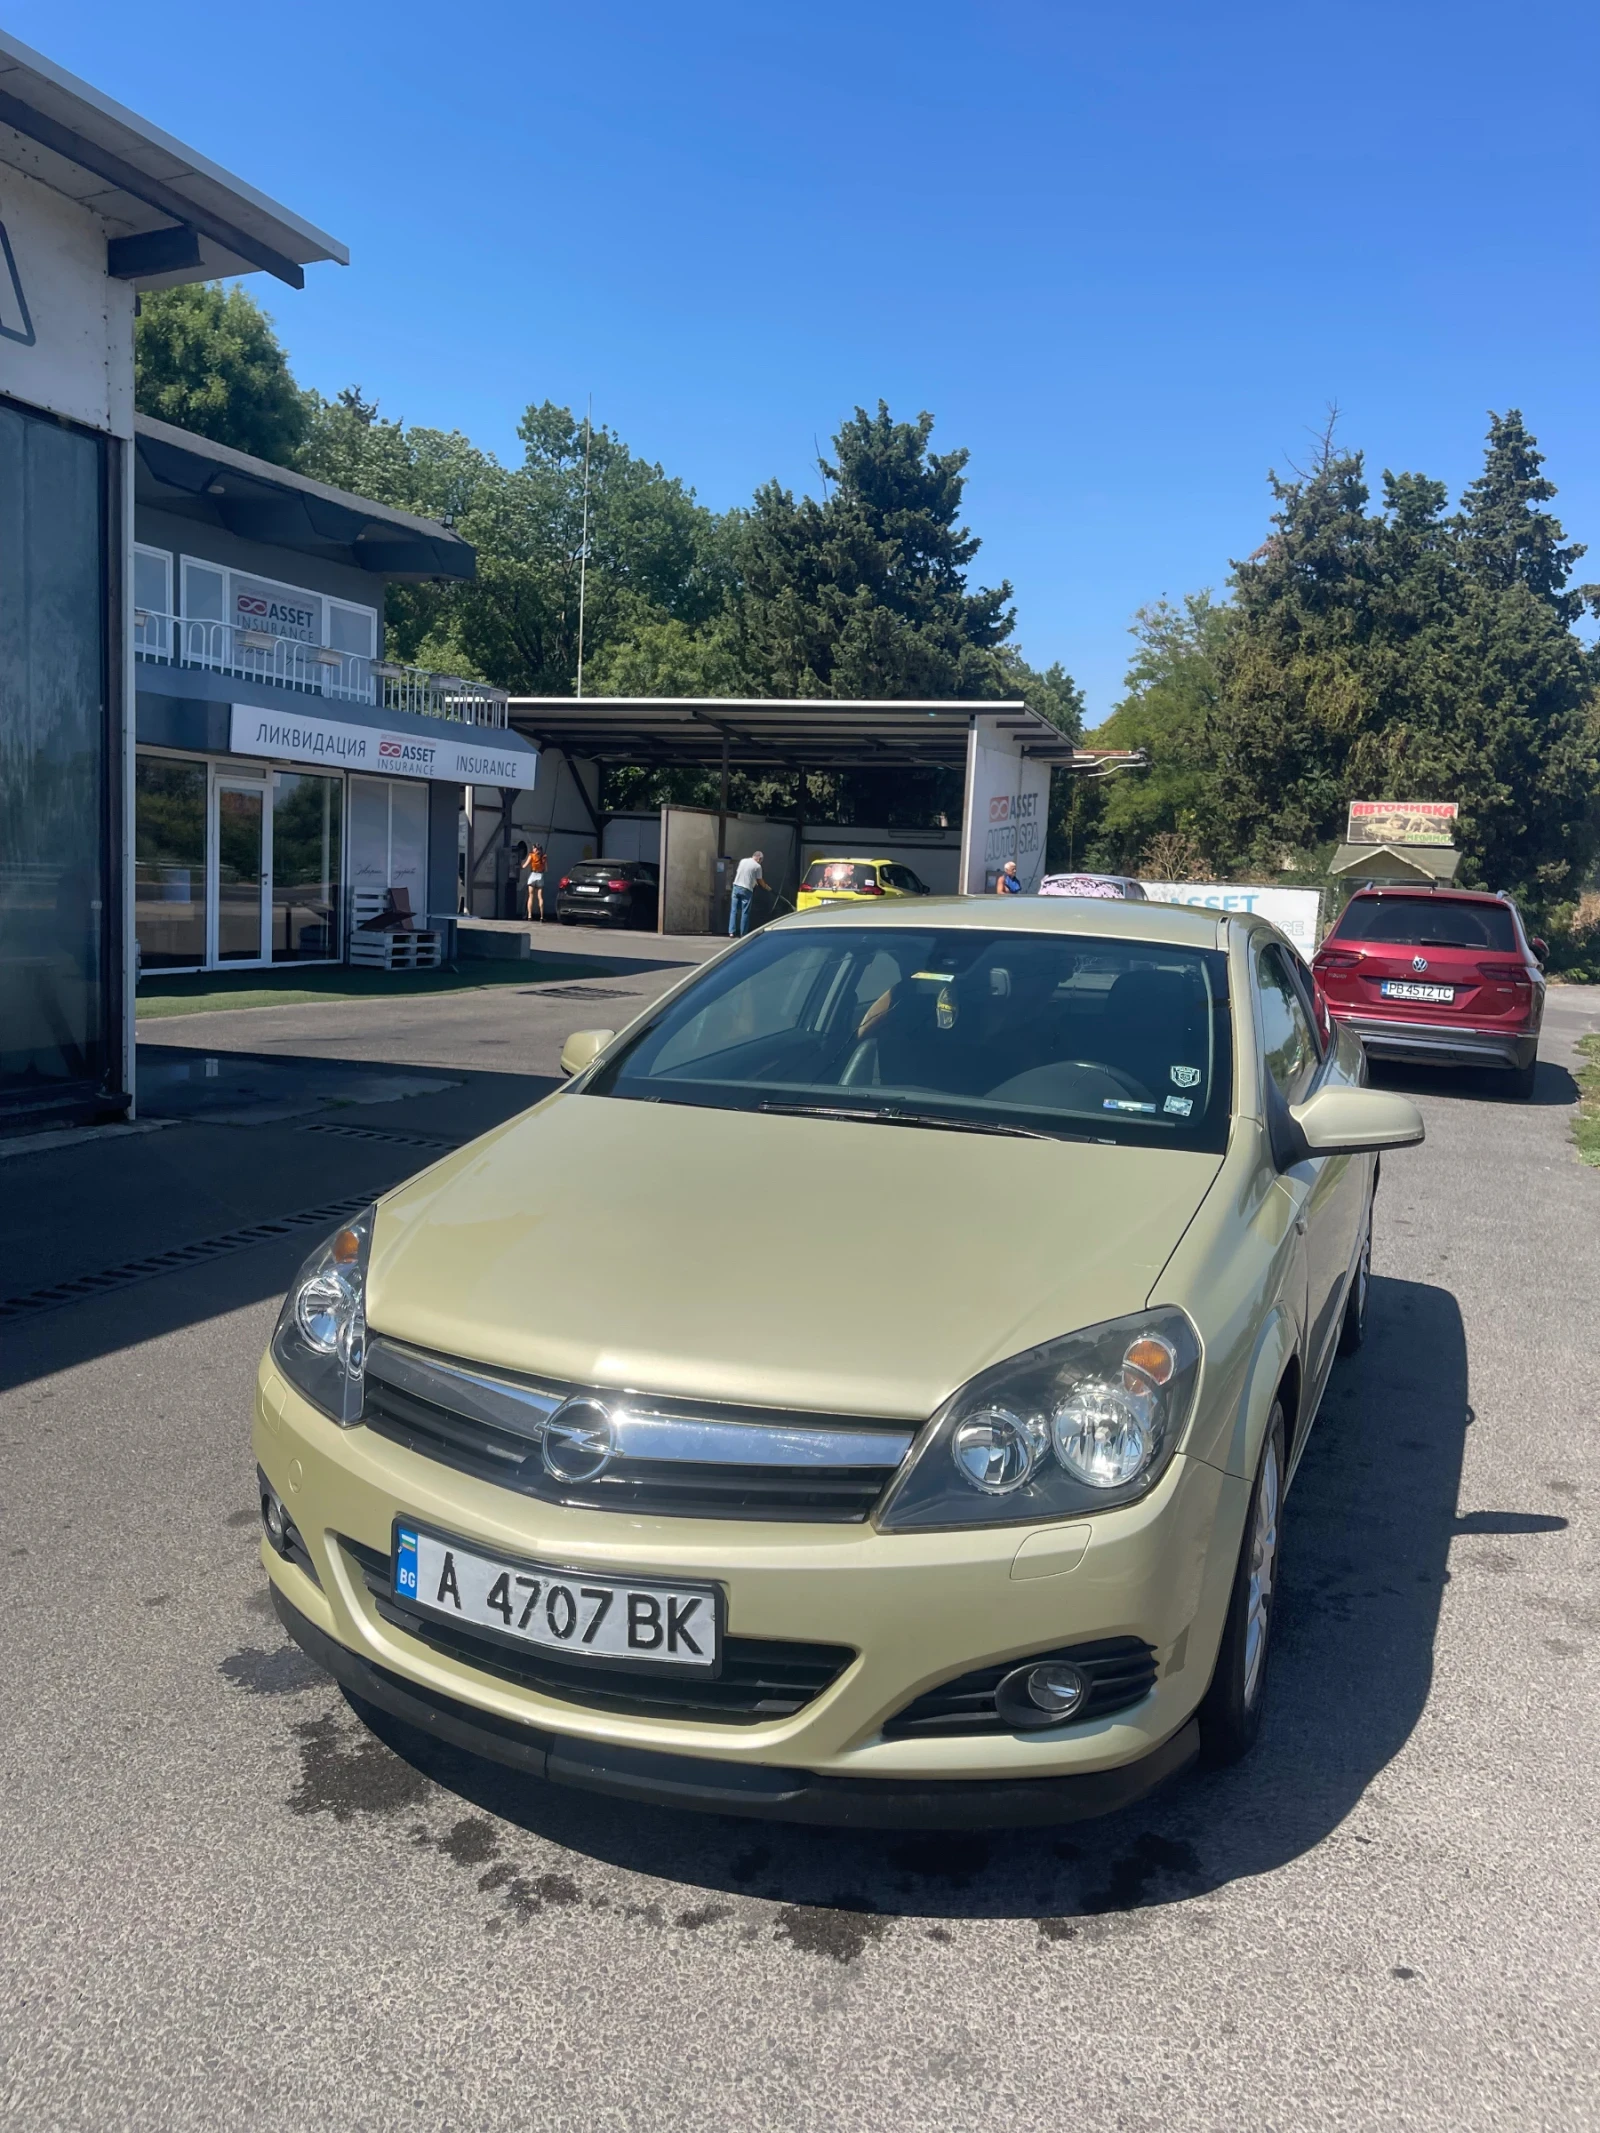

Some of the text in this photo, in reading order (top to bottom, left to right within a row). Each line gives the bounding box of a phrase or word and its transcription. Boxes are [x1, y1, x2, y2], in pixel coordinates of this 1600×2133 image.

[269, 603, 314, 628] ASSET
[236, 614, 315, 644] INSURANCE
[256, 723, 366, 759] ЛИКВИДАЦИЯ
[401, 745, 436, 763] ASSET
[377, 758, 435, 776] INSURANCE
[456, 755, 517, 778] INSURANCE
[1009, 793, 1038, 820] ASSET
[1352, 803, 1456, 818] АВТОМИВКА
[985, 821, 1039, 862] AUTO SPA
[1388, 982, 1405, 995] PB
[1405, 984, 1435, 998] 4512
[1435, 987, 1452, 999] TC
[399, 1567, 417, 1590] BG
[436, 1550, 705, 1656] A 4707 BK
